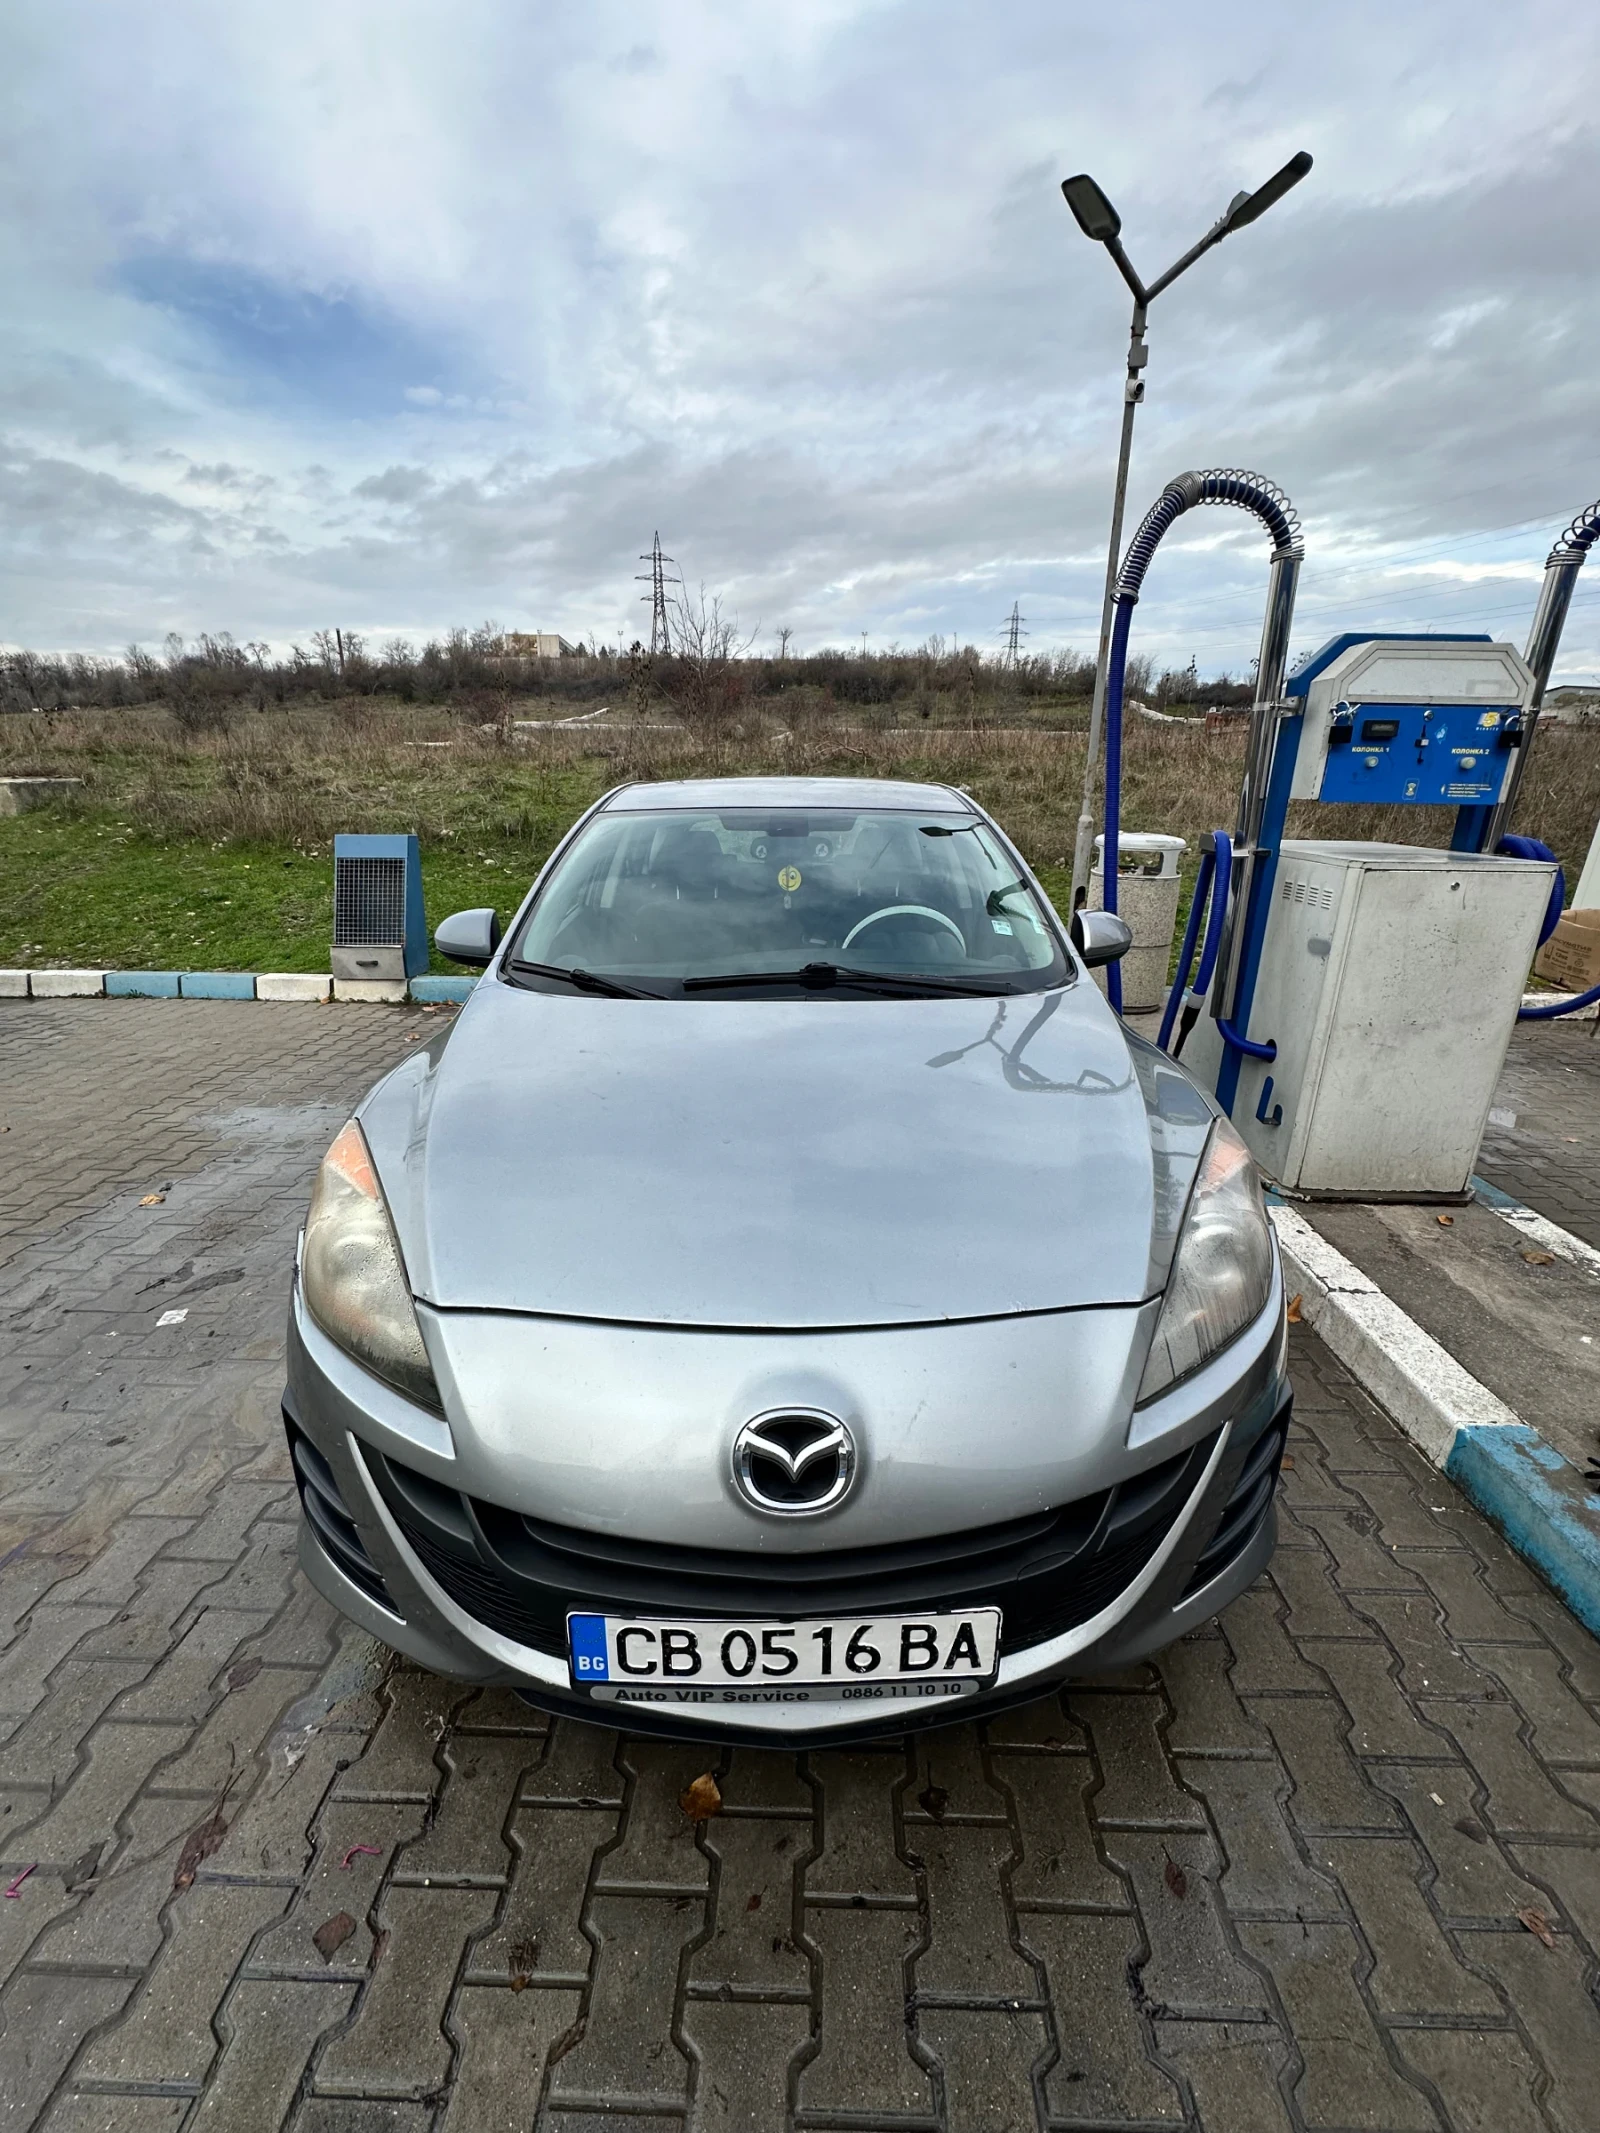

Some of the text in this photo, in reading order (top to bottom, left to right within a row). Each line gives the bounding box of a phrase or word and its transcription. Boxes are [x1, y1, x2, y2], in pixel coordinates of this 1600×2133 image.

[616, 1622, 982, 1678] CB 0516 BA
[578, 1656, 605, 1671] BG
[614, 1683, 962, 1703] Auto VIP Service 0886 11 10 10
